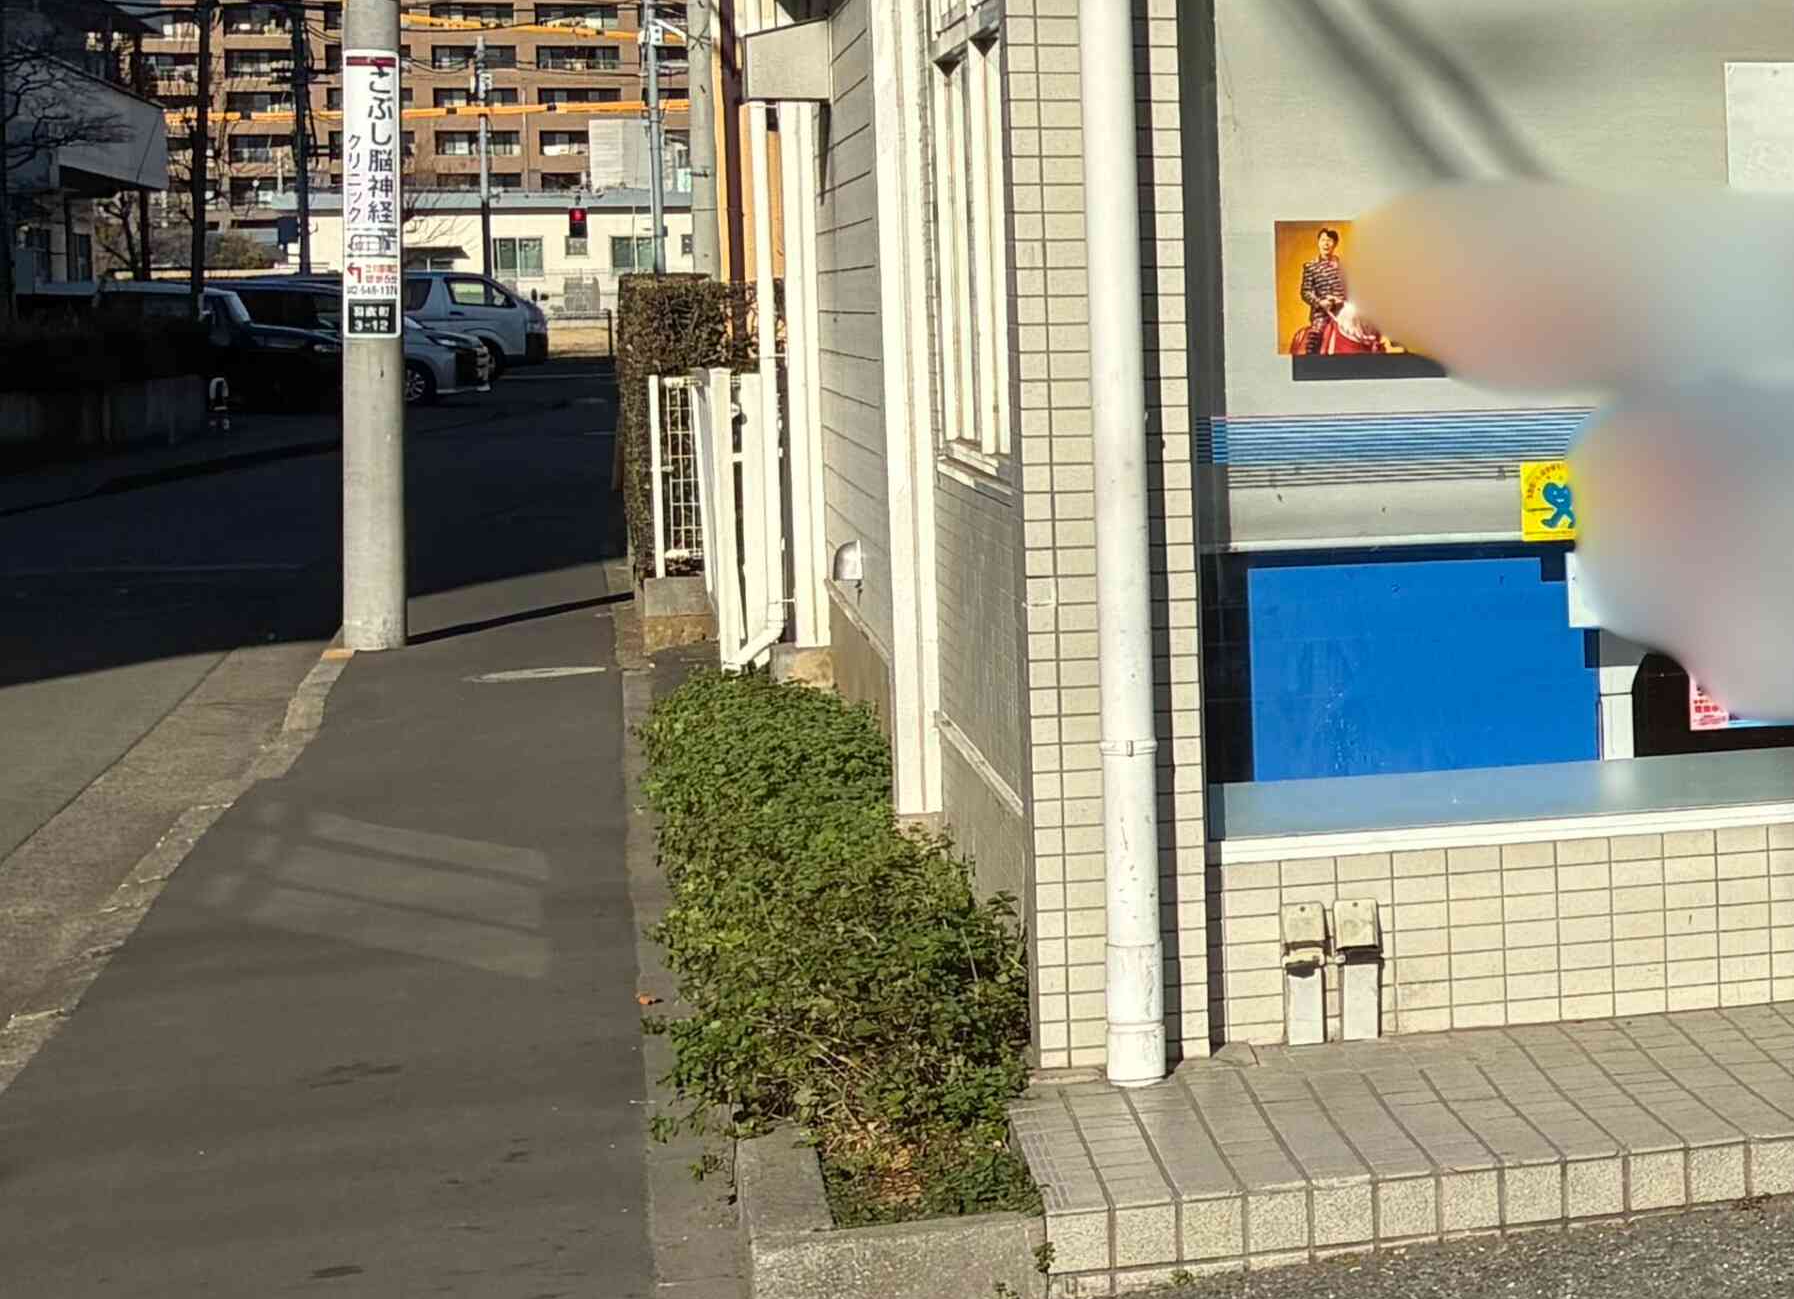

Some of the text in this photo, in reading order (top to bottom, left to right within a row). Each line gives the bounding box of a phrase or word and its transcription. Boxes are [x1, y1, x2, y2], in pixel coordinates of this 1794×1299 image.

[348, 133, 362, 223] クリニック
[354, 320, 389, 331] 3-12
